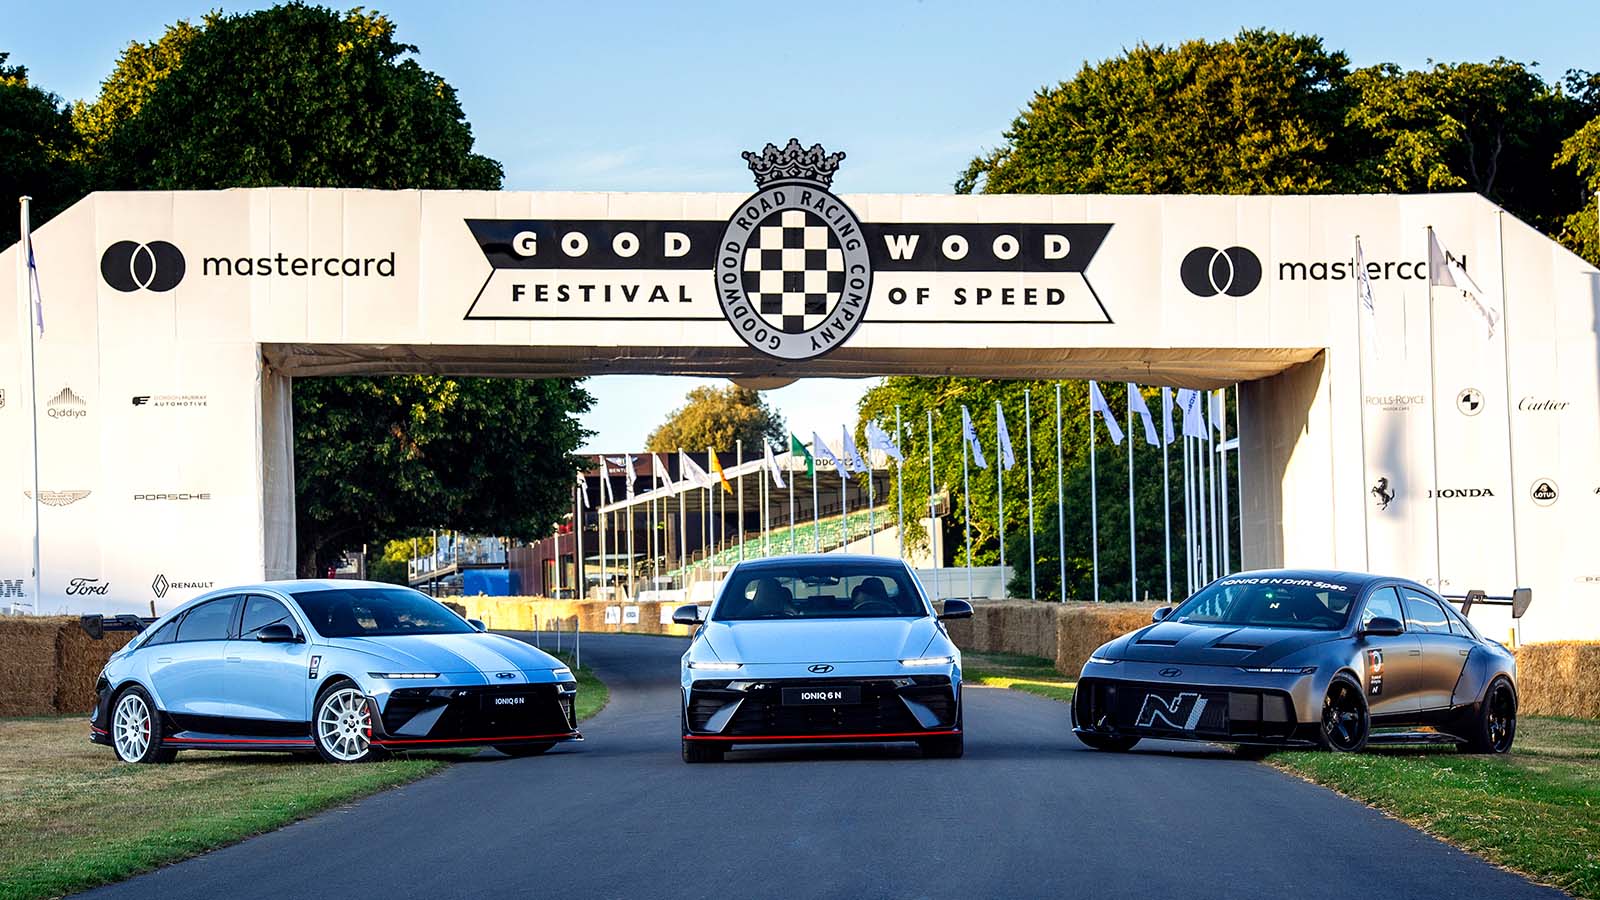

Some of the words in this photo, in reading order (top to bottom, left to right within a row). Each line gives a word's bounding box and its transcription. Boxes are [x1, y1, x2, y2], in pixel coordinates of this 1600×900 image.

[736, 190, 786, 232] ROAD
[800, 190, 861, 252] RACING
[512, 230, 692, 258] GOOD
[883, 234, 1072, 261] WOOD
[203, 251, 396, 278] mastercard
[511, 283, 693, 303] FESTIVAL
[722, 240, 782, 351] GOODWOOD
[888, 287, 930, 305] OF
[953, 287, 1066, 305] SPEED
[810, 263, 866, 351] COMPANY
[47, 408, 87, 419] Qiddiya
[1518, 396, 1570, 412] Cartier
[1429, 488, 1495, 498] HONDA
[65, 577, 110, 596] Ford
[171, 581, 214, 590] RENAULT
[1220, 578, 1260, 586] IONIQ
[1282, 578, 1313, 587] Drift
[1313, 581, 1348, 592] Spec
[495, 697, 514, 706] IONIQ
[514, 697, 519, 705] 6
[801, 691, 826, 700] IONIQ
[827, 692, 834, 700] 6
[834, 691, 842, 700] N
